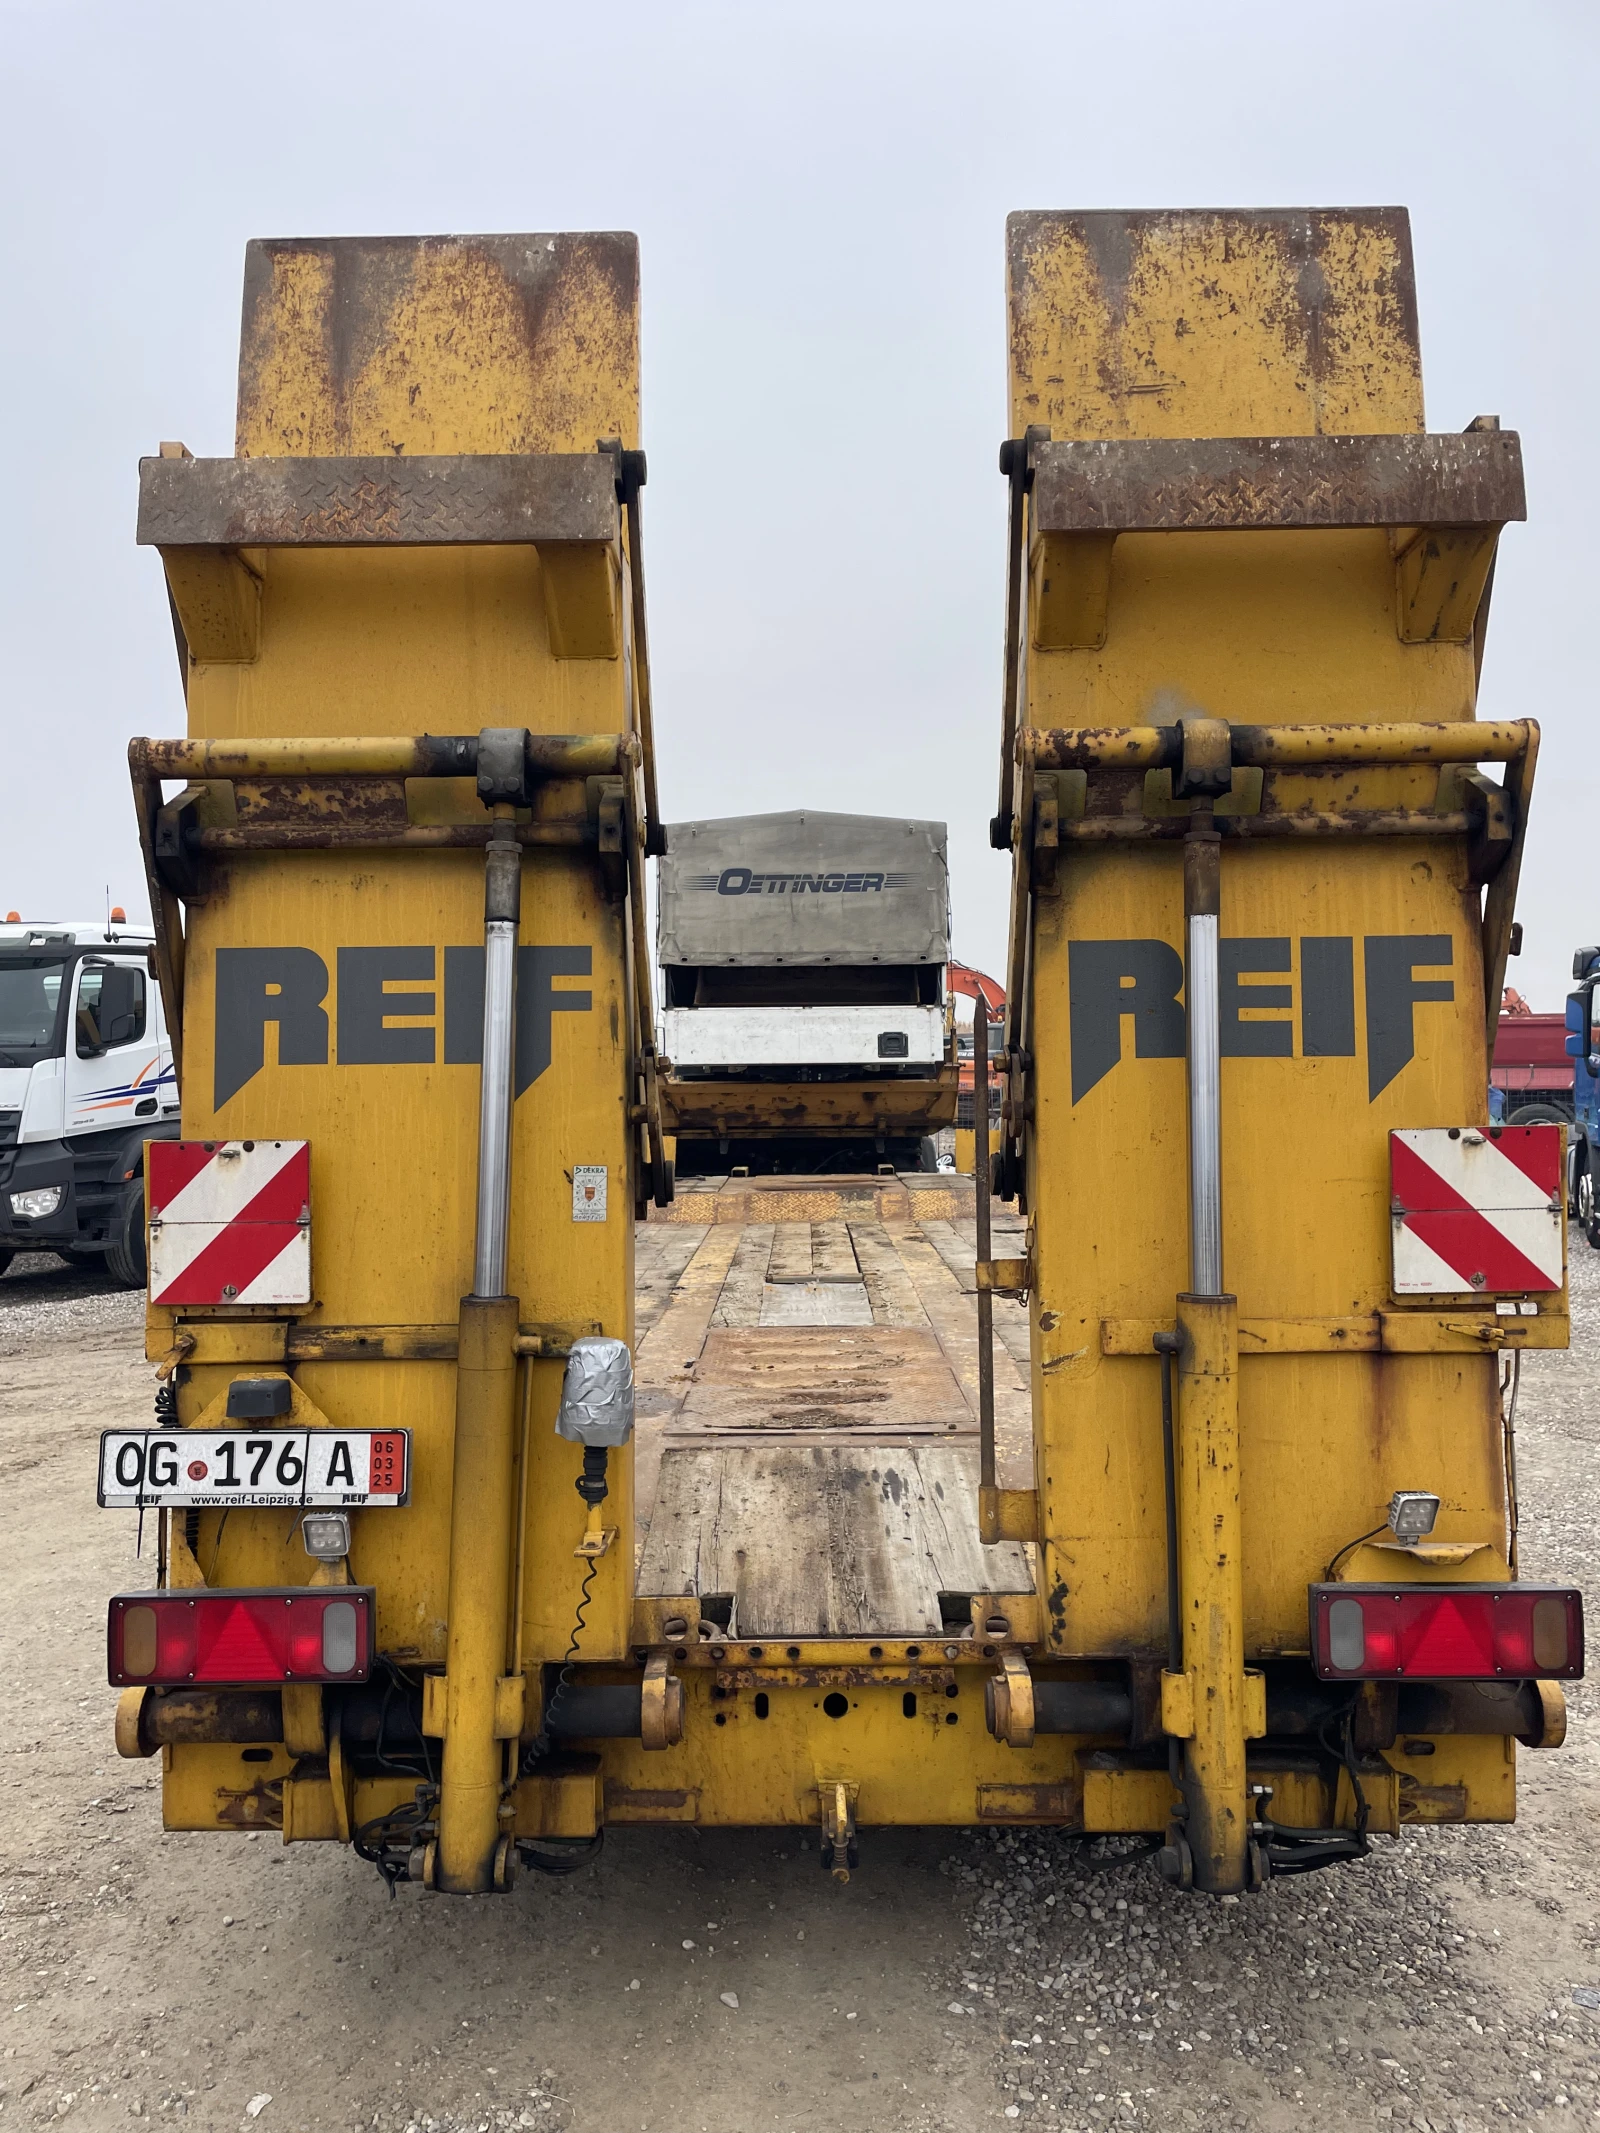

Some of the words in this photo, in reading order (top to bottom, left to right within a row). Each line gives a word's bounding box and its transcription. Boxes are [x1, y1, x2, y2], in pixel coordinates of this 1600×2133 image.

[717, 868, 886, 896] OETTINGER
[213, 945, 593, 1115] REIF
[1067, 934, 1455, 1108] REIF
[373, 1440, 394, 1453] 06
[115, 1440, 179, 1487] OG
[213, 1440, 303, 1487] 176
[325, 1440, 355, 1487] A
[373, 1457, 394, 1470] 03
[372, 1473, 394, 1486] 25
[341, 1493, 369, 1505] REIF
